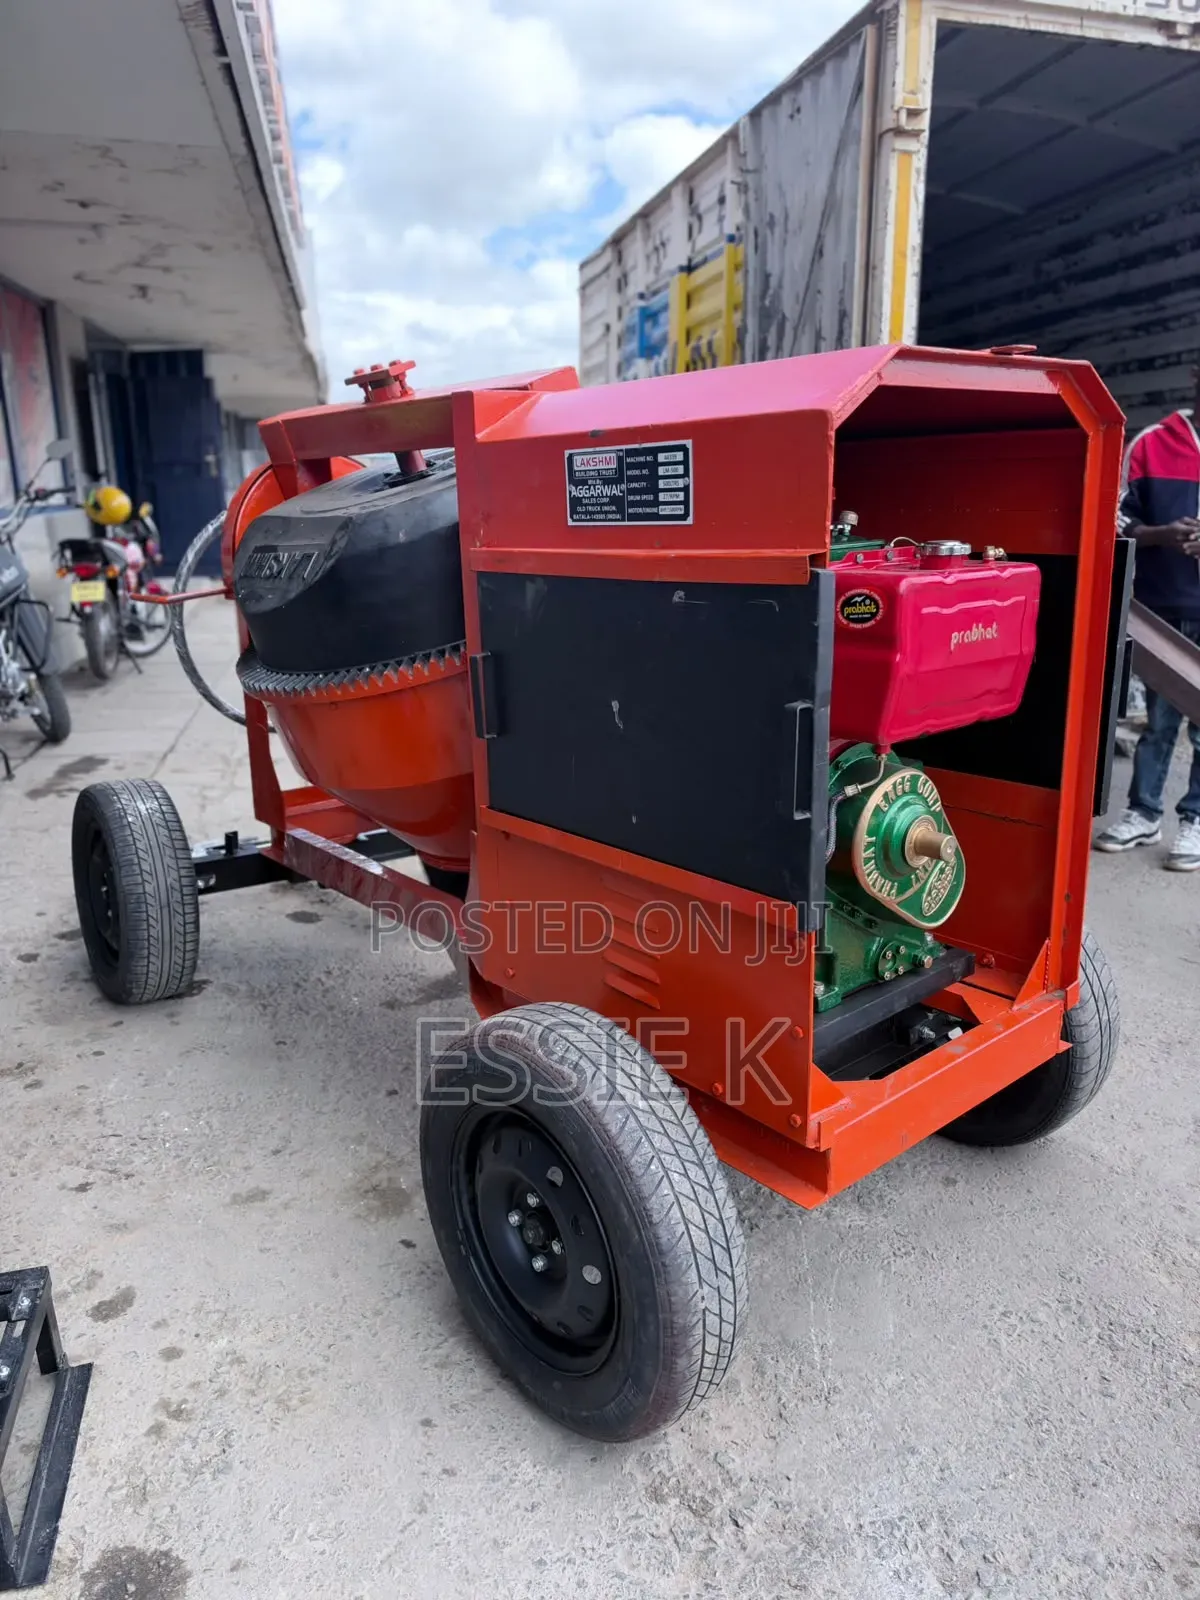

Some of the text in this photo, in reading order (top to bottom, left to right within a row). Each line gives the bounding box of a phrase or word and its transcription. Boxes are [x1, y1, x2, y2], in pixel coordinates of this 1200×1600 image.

[575, 455, 615, 468] LAKSHMI
[571, 484, 623, 497] AGGARWAL
[844, 601, 876, 617] prabhat
[951, 621, 998, 650] prabhat
